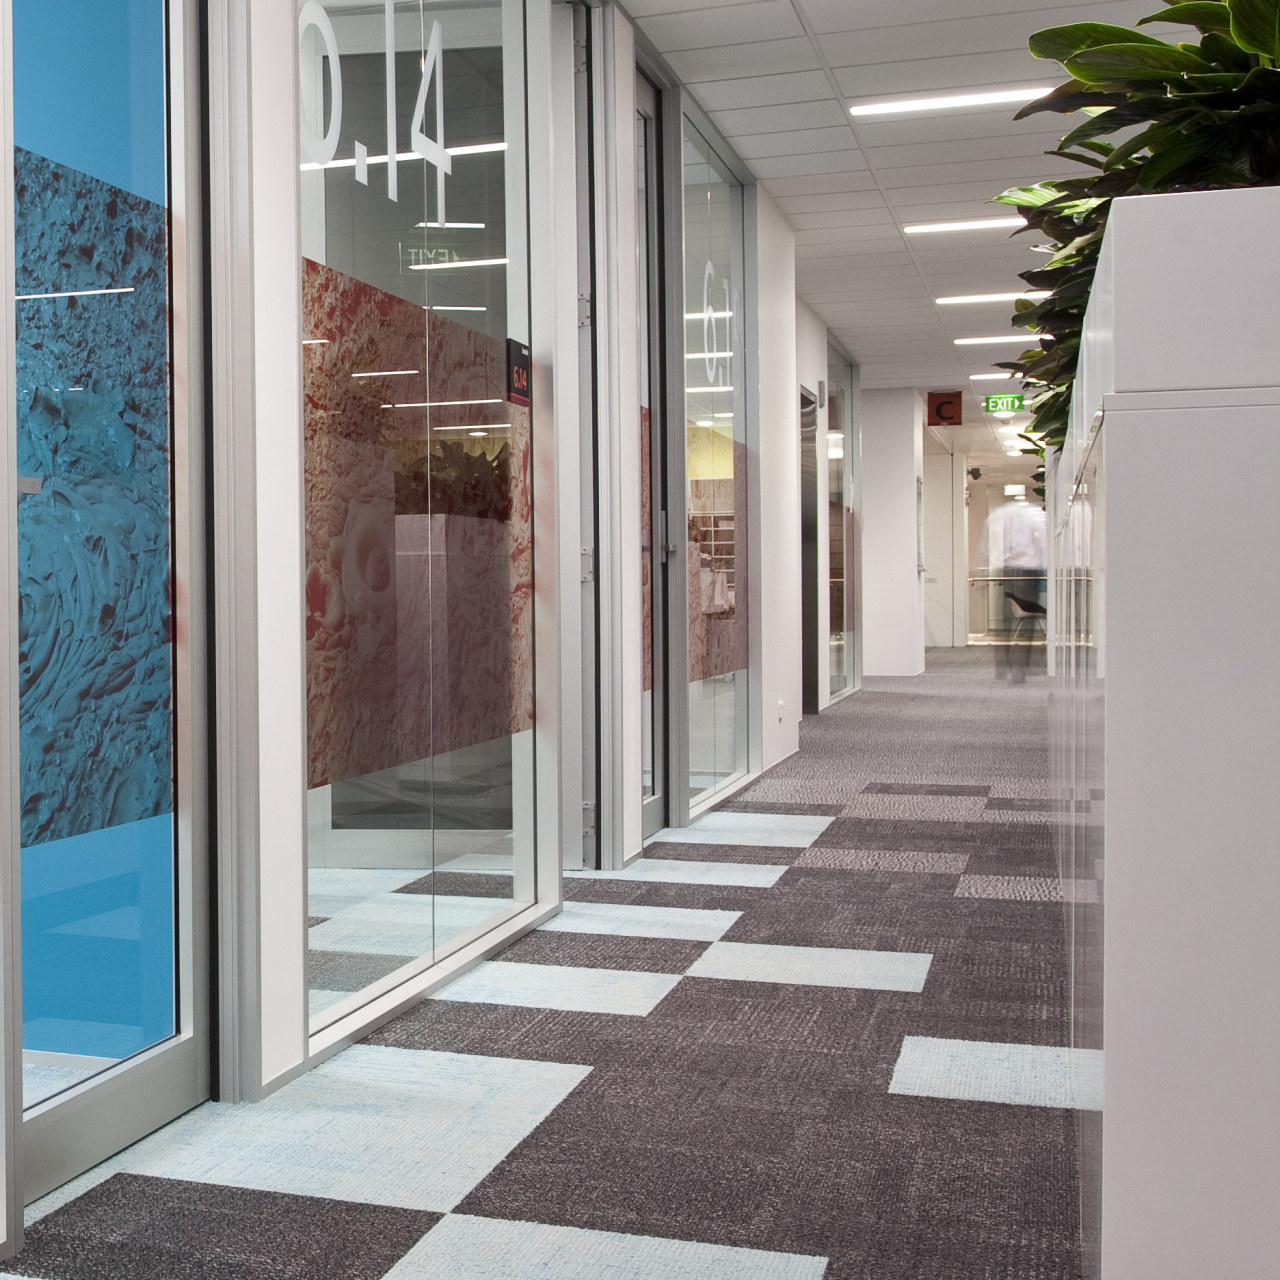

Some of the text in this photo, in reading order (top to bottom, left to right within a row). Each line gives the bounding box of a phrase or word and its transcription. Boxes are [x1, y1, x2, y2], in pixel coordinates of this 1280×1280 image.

[513, 366, 527, 390] 6.14
[935, 401, 954, 420] C
[989, 398, 1013, 410] EXIT
